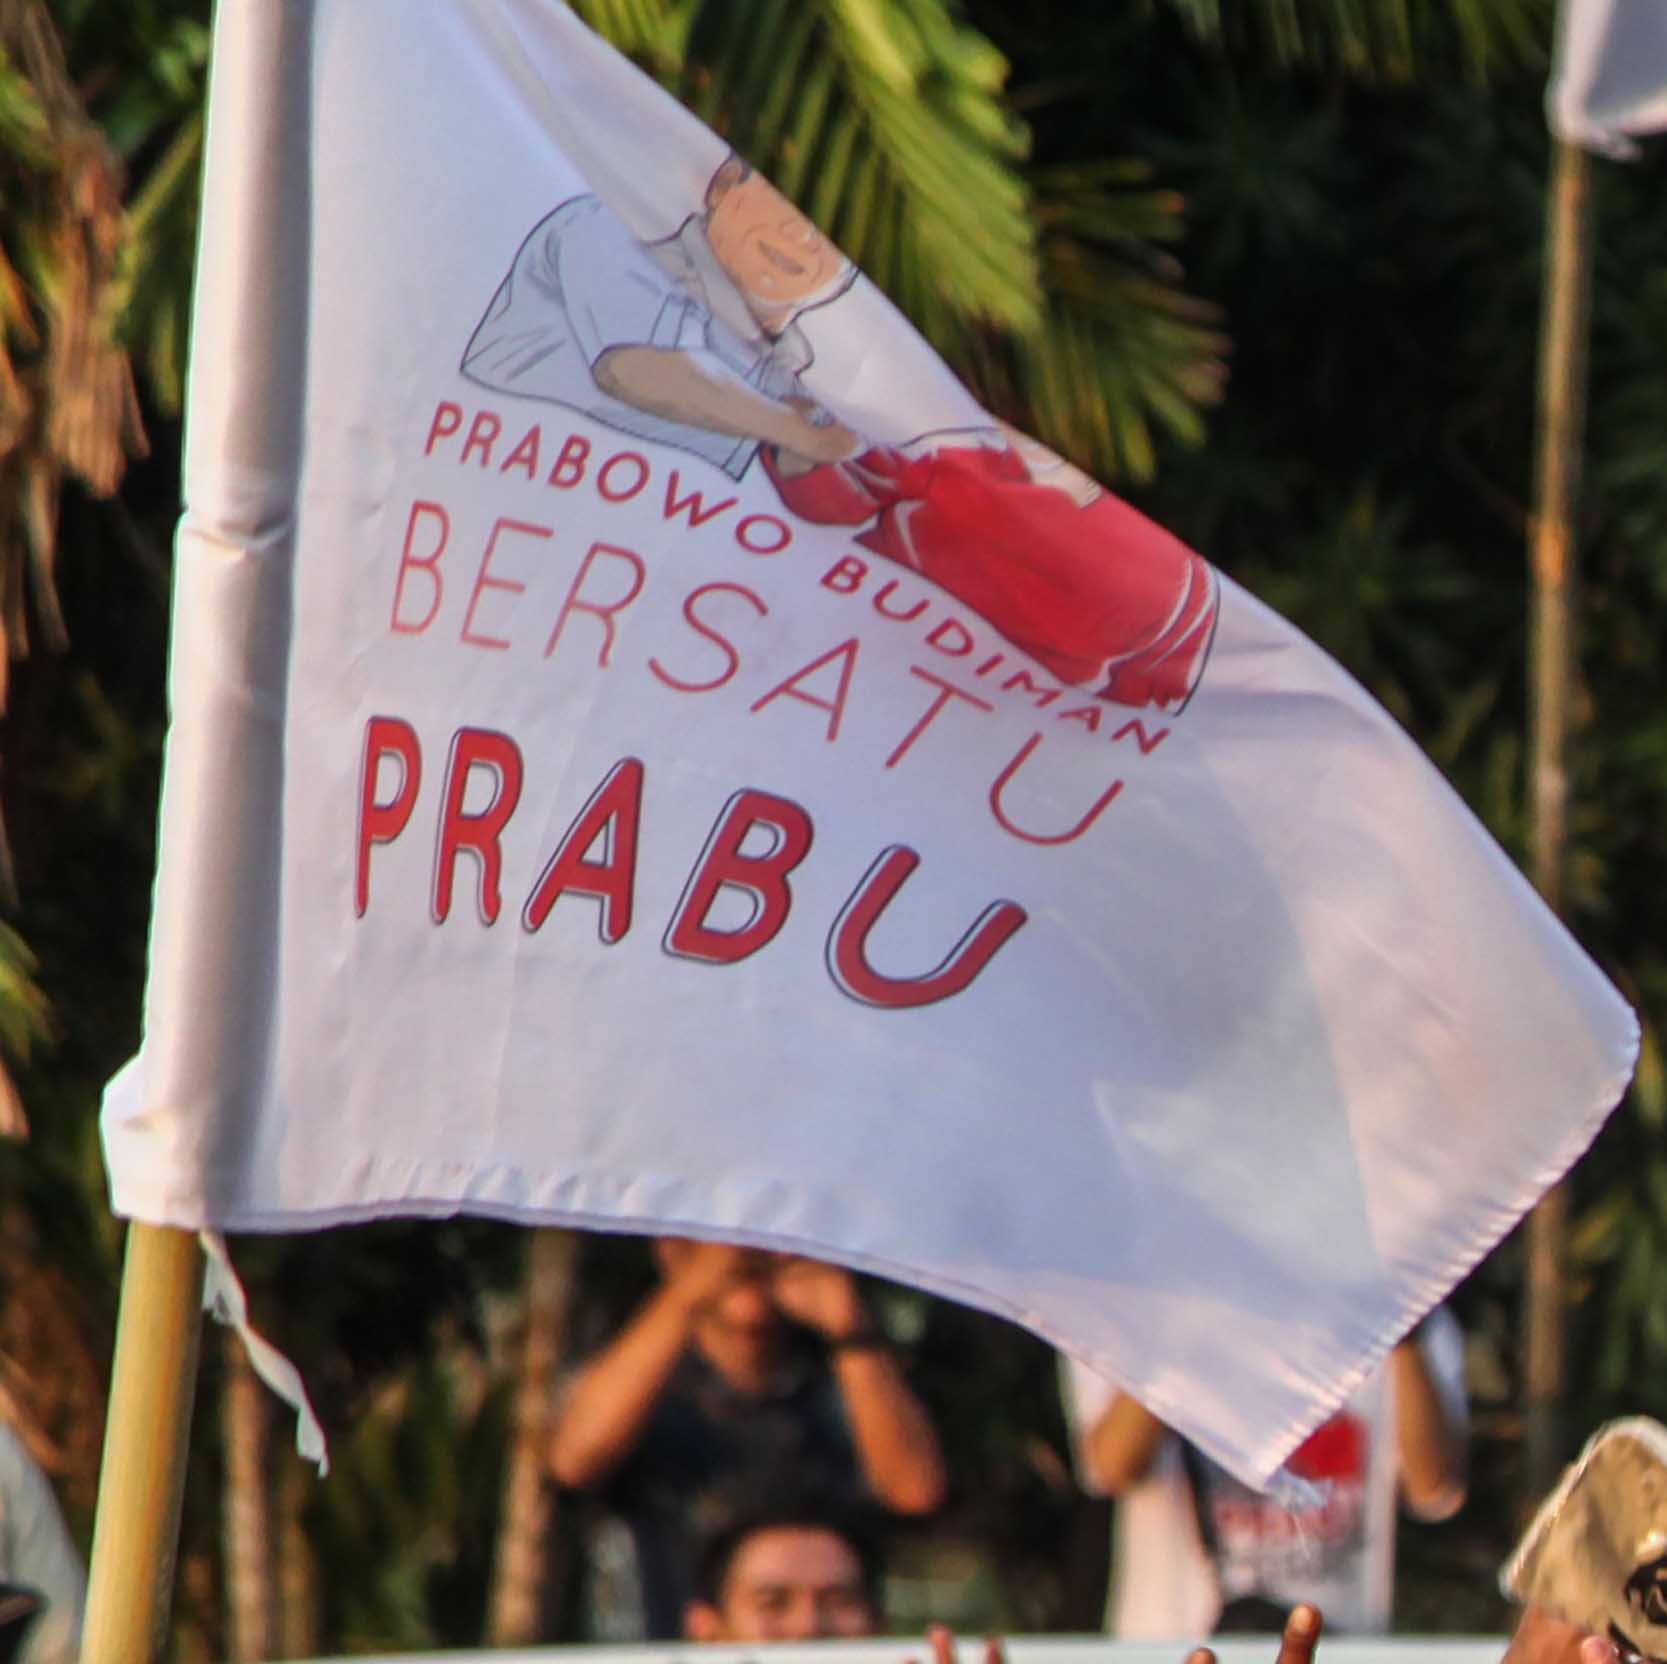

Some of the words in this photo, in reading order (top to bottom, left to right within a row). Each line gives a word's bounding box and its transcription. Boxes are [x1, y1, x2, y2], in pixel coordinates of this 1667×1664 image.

[389, 500, 1125, 846] BERSATU
[424, 400, 793, 556] PRABOWO
[819, 554, 1171, 756] BUDIMAN
[354, 714, 1029, 1009] PRABU
